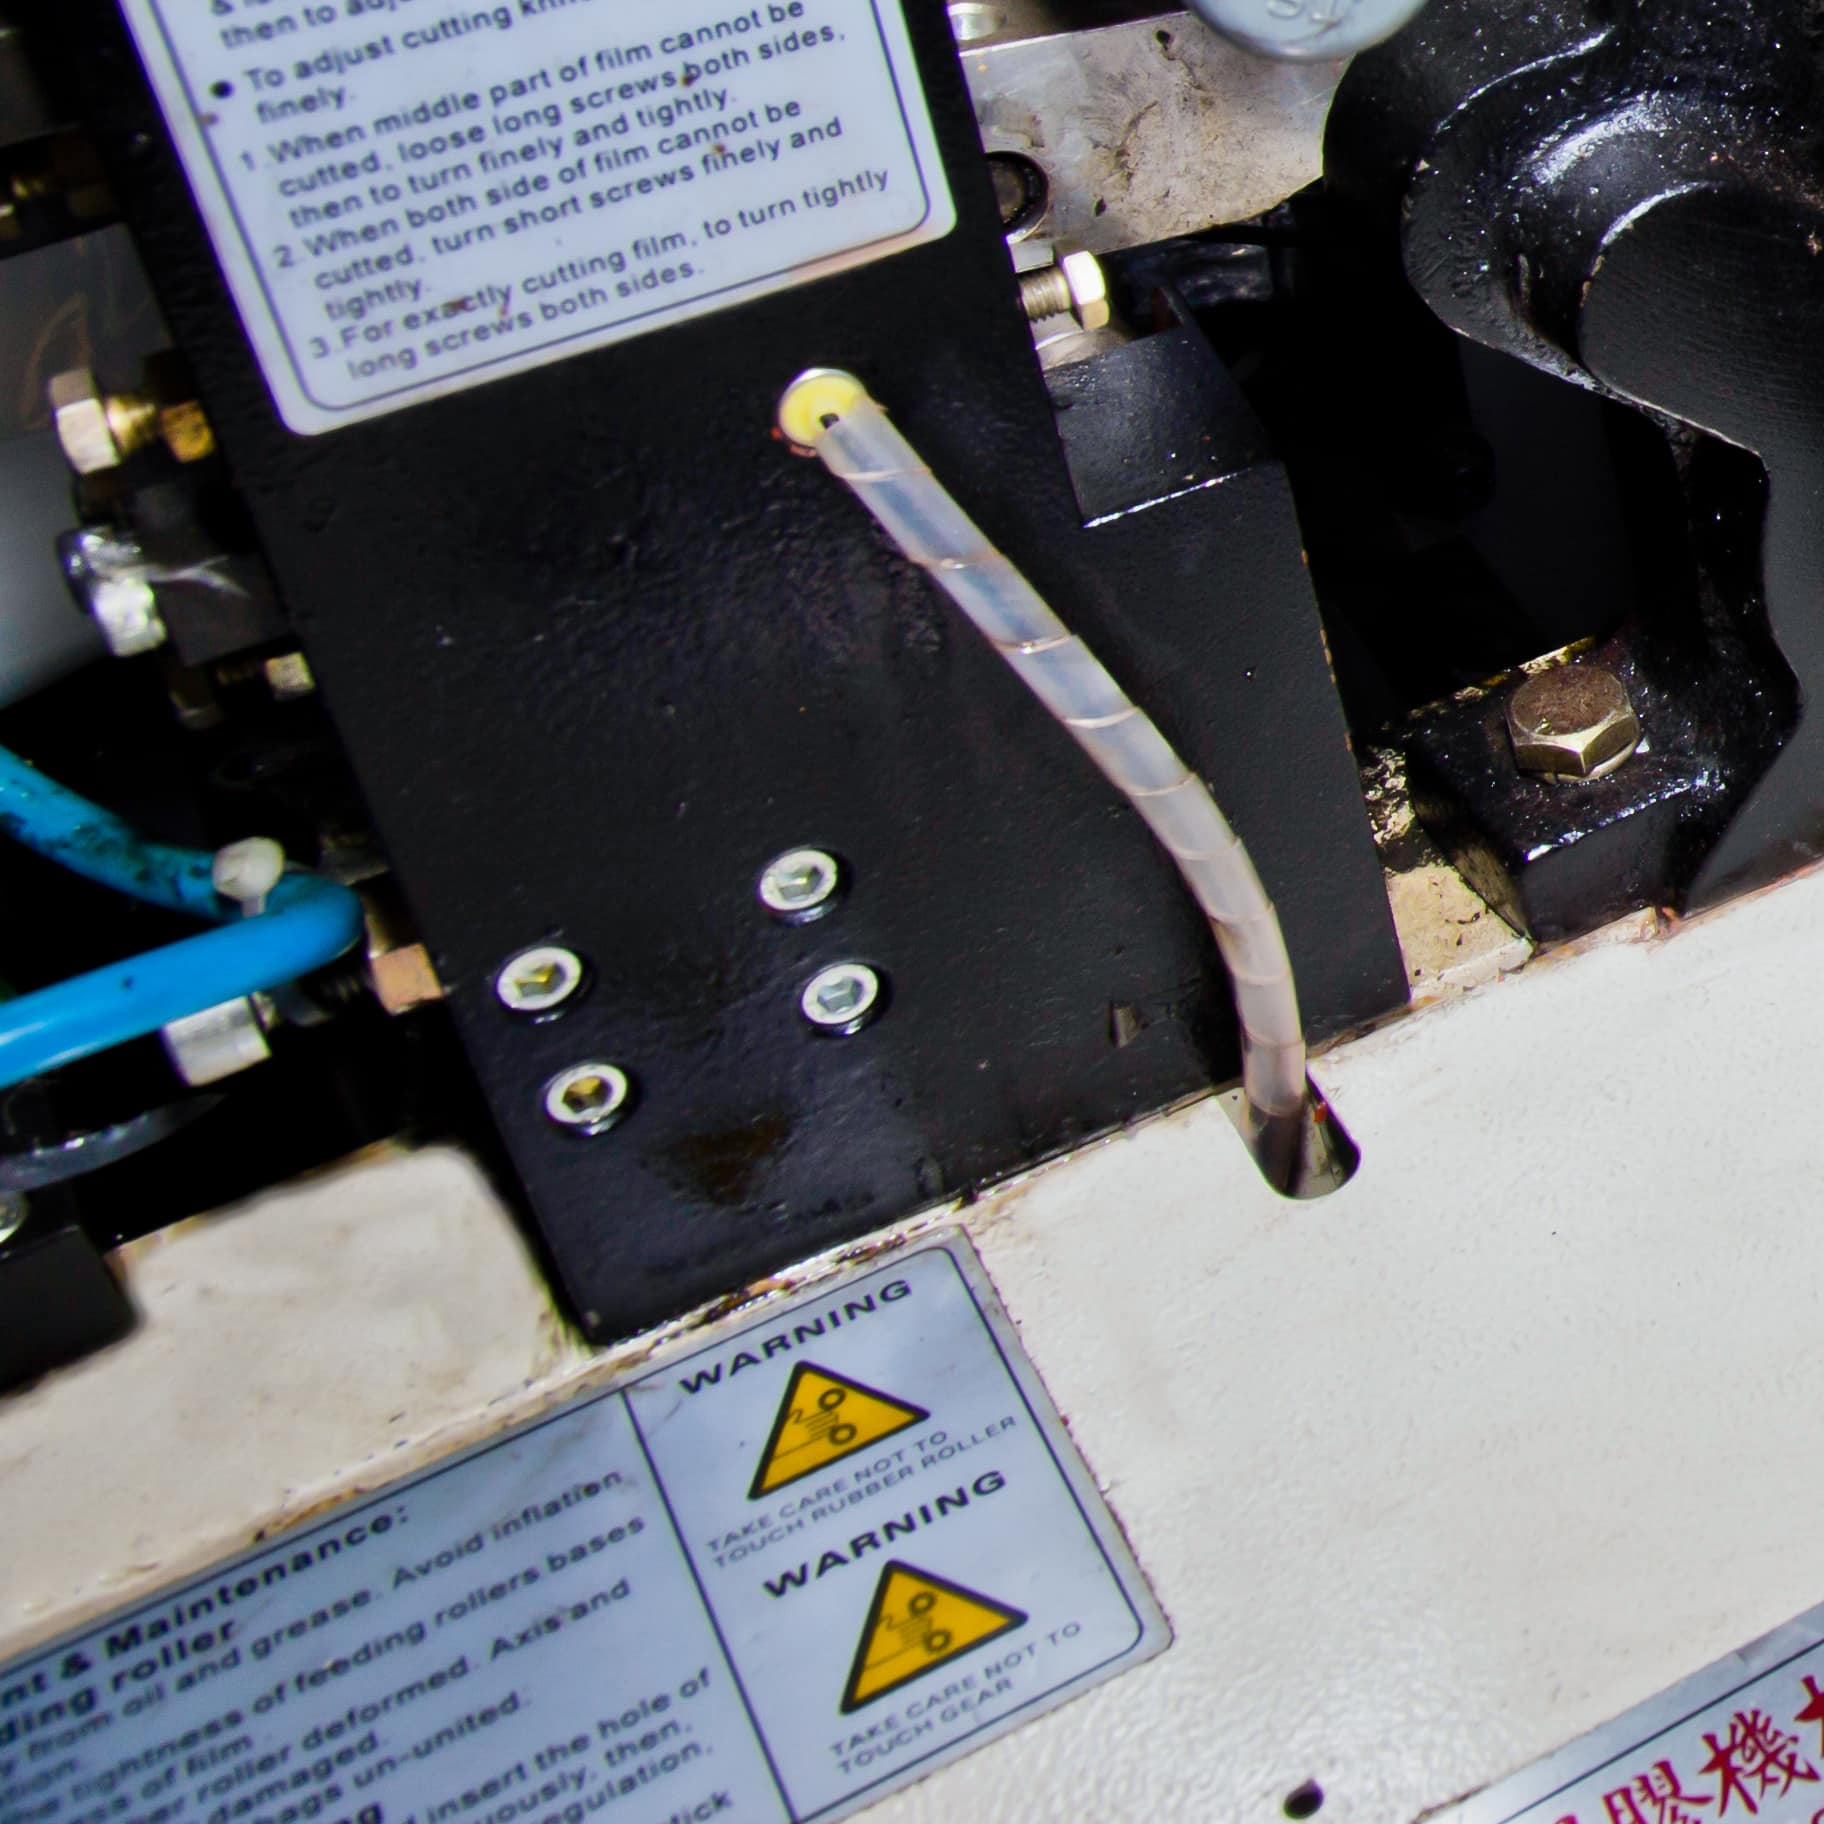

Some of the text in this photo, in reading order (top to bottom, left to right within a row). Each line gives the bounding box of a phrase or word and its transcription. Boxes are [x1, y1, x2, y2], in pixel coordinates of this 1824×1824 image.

[219, 15, 297, 48] then
[302, 5, 337, 26] to
[243, 67, 285, 90] To
[293, 35, 395, 79] adjust
[401, 5, 513, 49] cutting
[267, 0, 804, 163] When middle part of film cannot be
[397, 125, 486, 162] loose
[491, 103, 562, 135] long
[569, 70, 677, 114] screws
[680, 48, 749, 88] both
[288, 194, 363, 228] then
[368, 183, 401, 204] to
[407, 162, 471, 194] turn
[477, 136, 562, 173] finely
[573, 112, 629, 147] and
[302, 100, 800, 256] When both side of film cannot be
[430, 224, 495, 255] turn
[501, 194, 582, 234] short
[588, 164, 694, 208] screws
[701, 138, 779, 174] finely
[789, 116, 842, 149] and
[339, 319, 392, 347] For
[402, 284, 511, 330] exactly
[521, 250, 626, 294] cutting
[702, 218, 731, 238] to
[737, 199, 795, 228] turn
[801, 170, 887, 208] tightly
[347, 262, 703, 378] long screws both sides.
[677, 1279, 911, 1396] WARNING
[705, 1430, 947, 1553] TAKE CARE NOT TO
[712, 1415, 1016, 1567] TOUCH RUBBER ROLLER
[761, 1469, 1006, 1599] WARNING
[109, 1618, 241, 1693] roller
[121, 1681, 167, 1717] oil
[175, 1645, 241, 1693] and
[392, 1529, 486, 1590] Avoid
[250, 1680, 288, 1715] of
[292, 1620, 427, 1694] feeding
[433, 1565, 543, 1628] rollers
[545, 1516, 645, 1573] bases
[196, 1742, 292, 1804] roller
[489, 1608, 565, 1662] Axis
[560, 1576, 631, 1622] and
[533, 1733, 591, 1772] the
[596, 1693, 672, 1740] hole
[678, 1666, 710, 1699] of
[829, 1621, 1081, 1756] TAKE CARE NOT TO
[837, 1676, 1013, 1774] TOUCH GEAR
[139, 1764, 177, 1800] of
